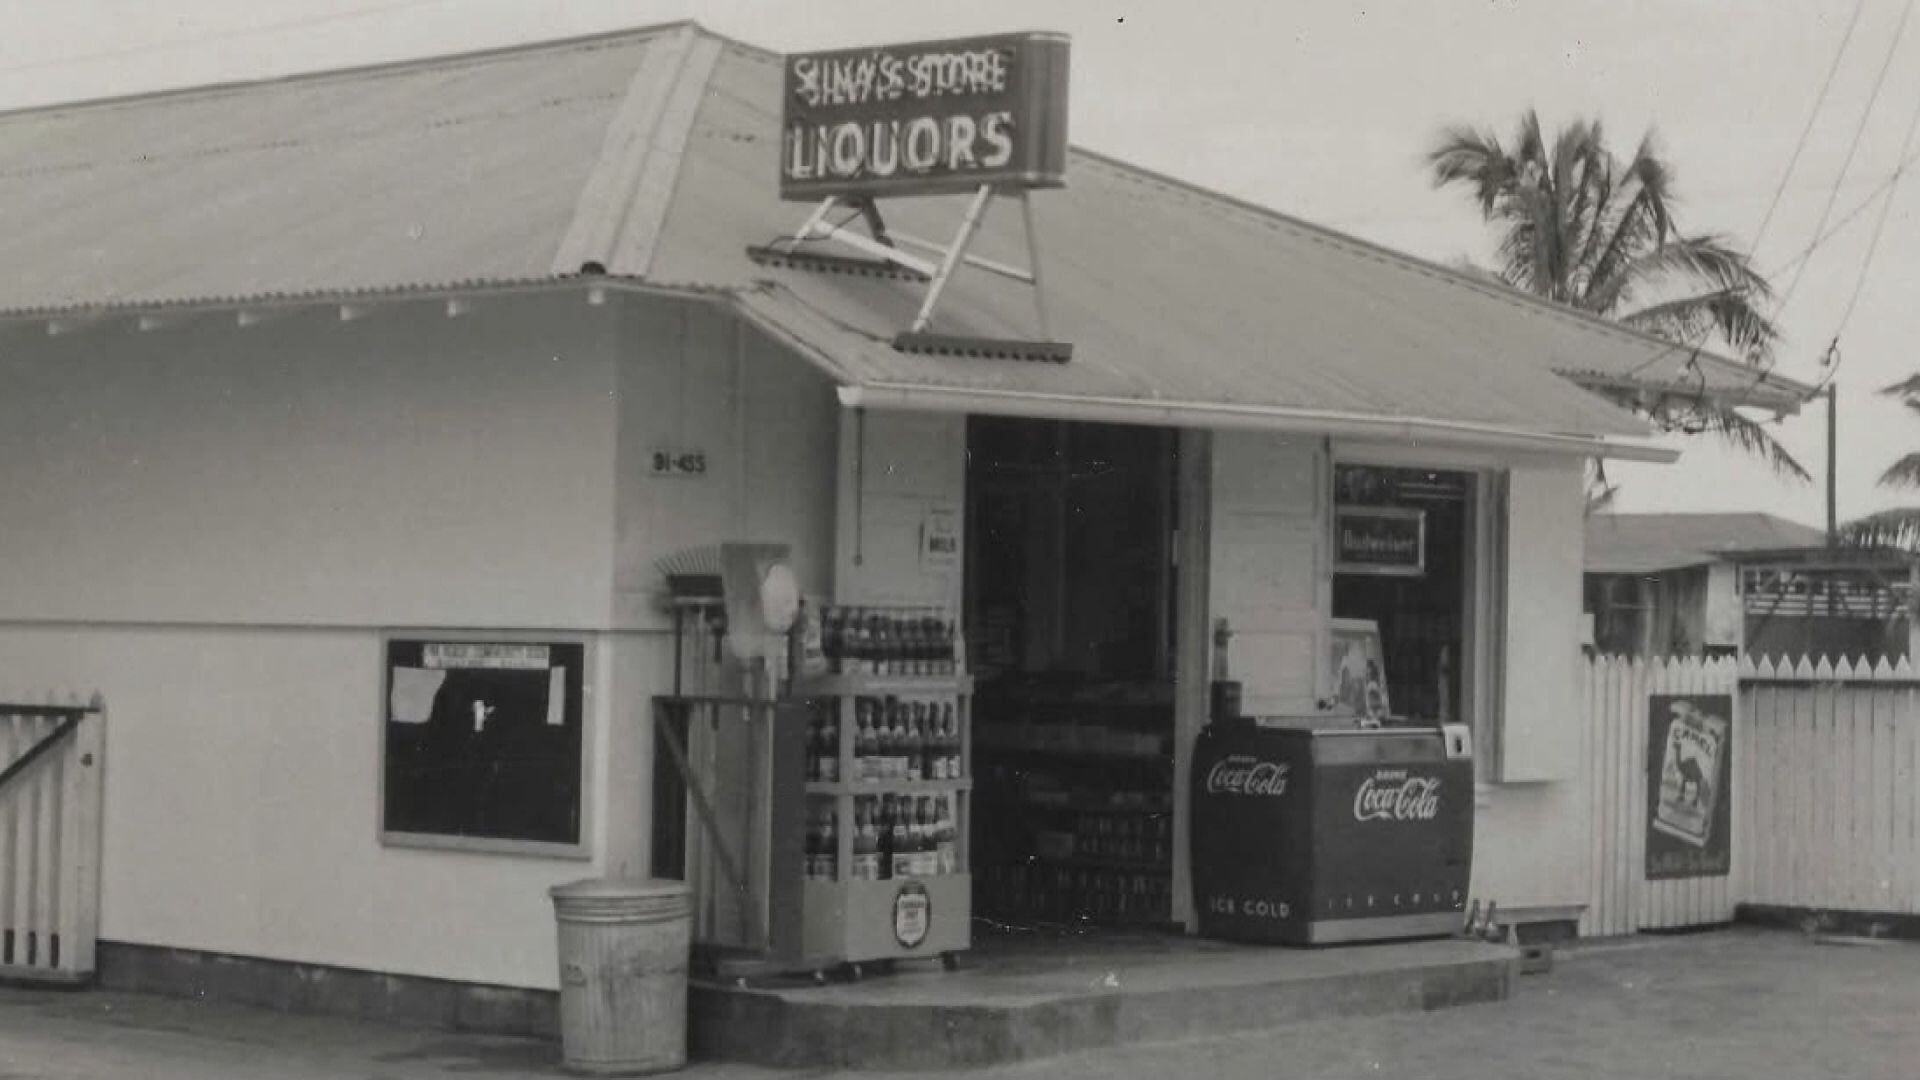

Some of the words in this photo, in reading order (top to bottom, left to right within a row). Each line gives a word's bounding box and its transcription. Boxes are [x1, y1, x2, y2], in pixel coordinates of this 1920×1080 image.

[907, 50, 1007, 97] STORE
[789, 111, 1013, 180] LIQUORS
[1207, 760, 1289, 796] Coca-Cola
[1354, 777, 1441, 821] Coca-Cola
[1209, 896, 1235, 914] ICE
[1243, 899, 1290, 919] COLD
